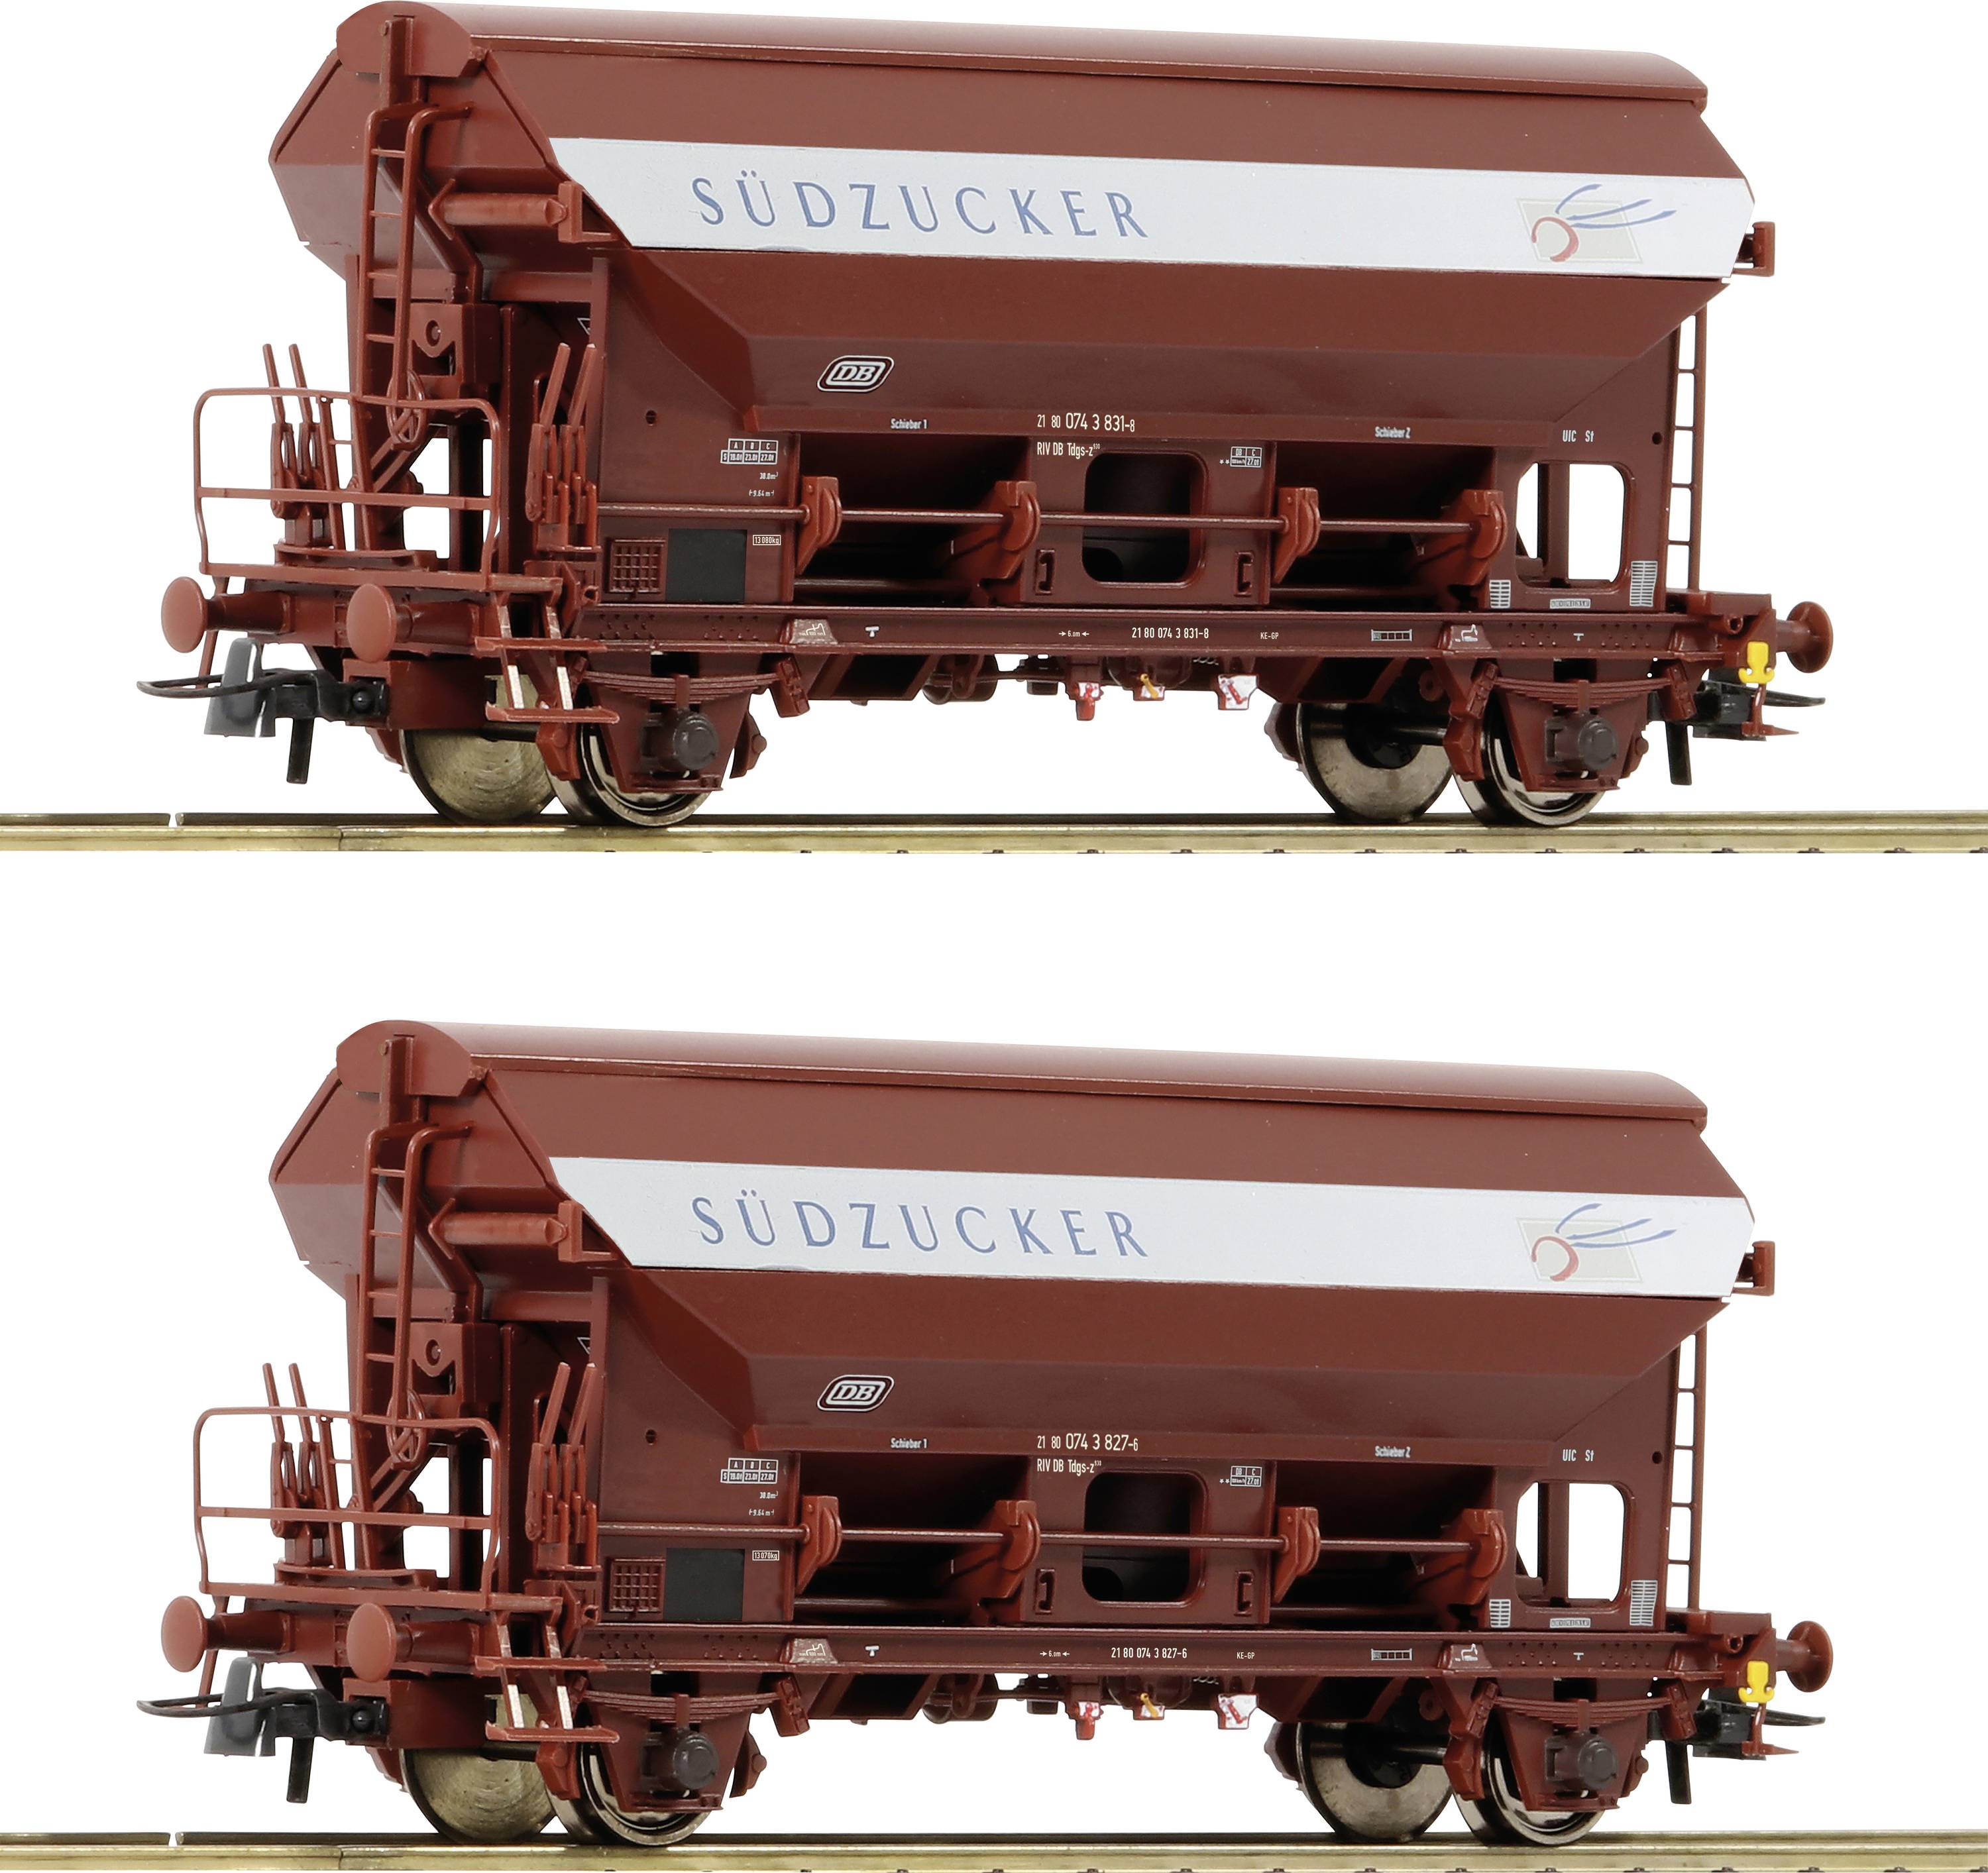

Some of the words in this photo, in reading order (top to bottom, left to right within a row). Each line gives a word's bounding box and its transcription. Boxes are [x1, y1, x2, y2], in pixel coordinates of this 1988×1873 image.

[691, 170, 1148, 238] SÜDZUCKER
[832, 366, 875, 381] DB
[891, 418, 921, 429] Schieber
[923, 419, 927, 429] 1
[1037, 414, 1045, 427] 21
[1051, 415, 1060, 428] 80
[1066, 413, 1088, 429] 074
[1092, 414, 1100, 430] 3
[1104, 415, 1135, 432] 831-8
[1375, 426, 1405, 438] Schieber
[1563, 429, 1576, 442] UIC
[1037, 442, 1050, 455] RIV
[1053, 443, 1064, 455] DB
[1132, 627, 1141, 638] 21
[1144, 628, 1155, 638] 80
[1158, 628, 1172, 638] 074
[1176, 628, 1181, 639] 3
[1184, 628, 1209, 639] 831-8
[691, 1190, 1148, 1258] SÜDZUCKER
[832, 1385, 875, 1401] DB
[891, 1438, 921, 1449] Schieber
[923, 1438, 927, 1449] 1
[1037, 1436, 1045, 1448] 21
[1051, 1436, 1060, 1449] 80
[1066, 1433, 1088, 1450] 074
[1092, 1434, 1100, 1450] 3
[1105, 1434, 1138, 1451] 827-6
[1375, 1446, 1405, 1458] Schieber
[1563, 1449, 1576, 1462] UIC
[1037, 1459, 1050, 1472] RIV
[1053, 1459, 1064, 1472] DB
[1111, 1647, 1120, 1658] 21
[1123, 1648, 1134, 1658] 80
[1136, 1648, 1150, 1658] 074
[1154, 1648, 1159, 1658] 3
[1162, 1648, 1187, 1658] 827-6
